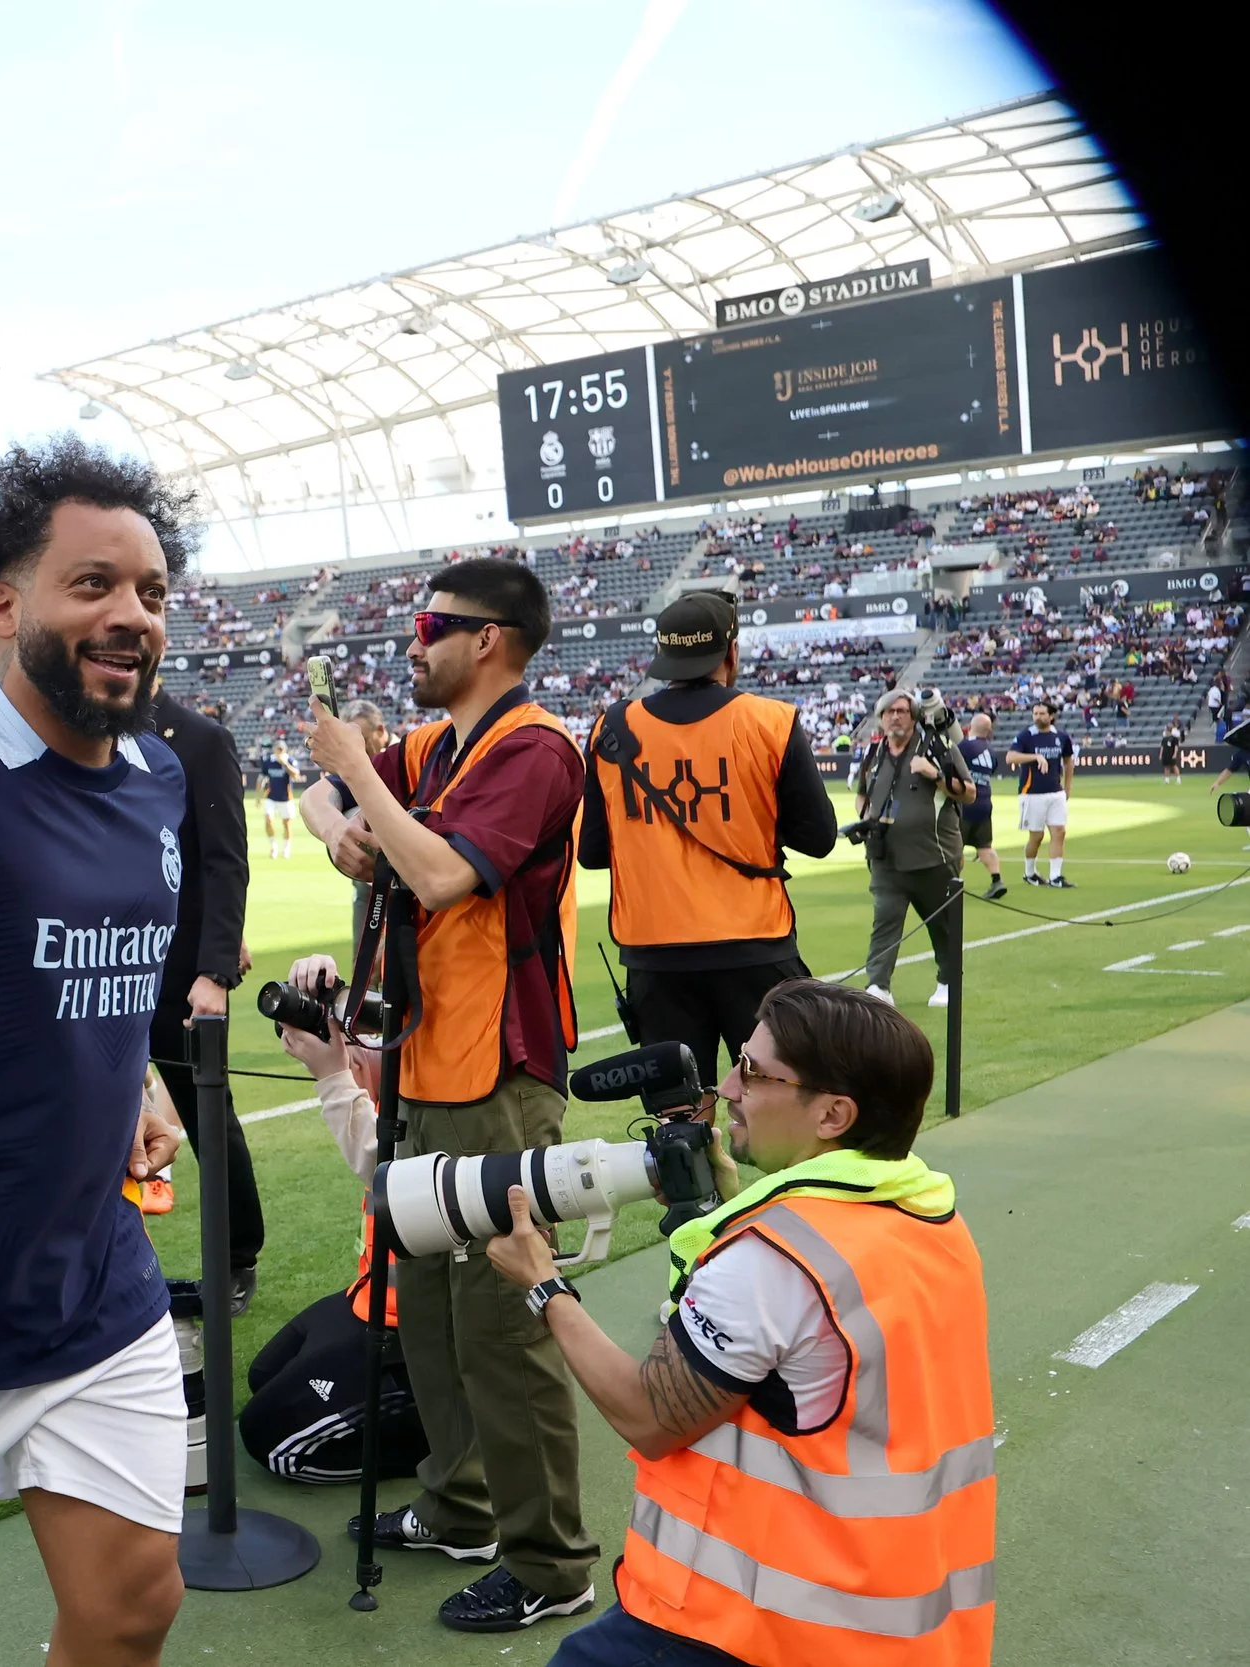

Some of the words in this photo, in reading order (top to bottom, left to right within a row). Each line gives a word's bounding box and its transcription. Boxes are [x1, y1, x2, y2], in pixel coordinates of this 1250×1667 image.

[724, 297, 776, 323] BMO
[808, 267, 919, 307] STADIUM
[1140, 335, 1164, 355] OF
[797, 363, 847, 385] INSIDE
[850, 358, 878, 377] JOB
[524, 369, 628, 422] 17:55
[723, 444, 939, 487] @WeAreHouseOfHeroes
[547, 483, 563, 509] 0
[597, 476, 614, 502] 0
[1167, 578, 1197, 590] BMO
[865, 602, 891, 614] BMO
[668, 630, 714, 647] Angeles
[1095, 755, 1108, 766] OF
[1111, 754, 1151, 766] HEROES
[369, 893, 384, 930] Canon
[56, 978, 93, 1019] FLY
[97, 972, 156, 1018] BETTER
[589, 1059, 662, 1092] RØDE
